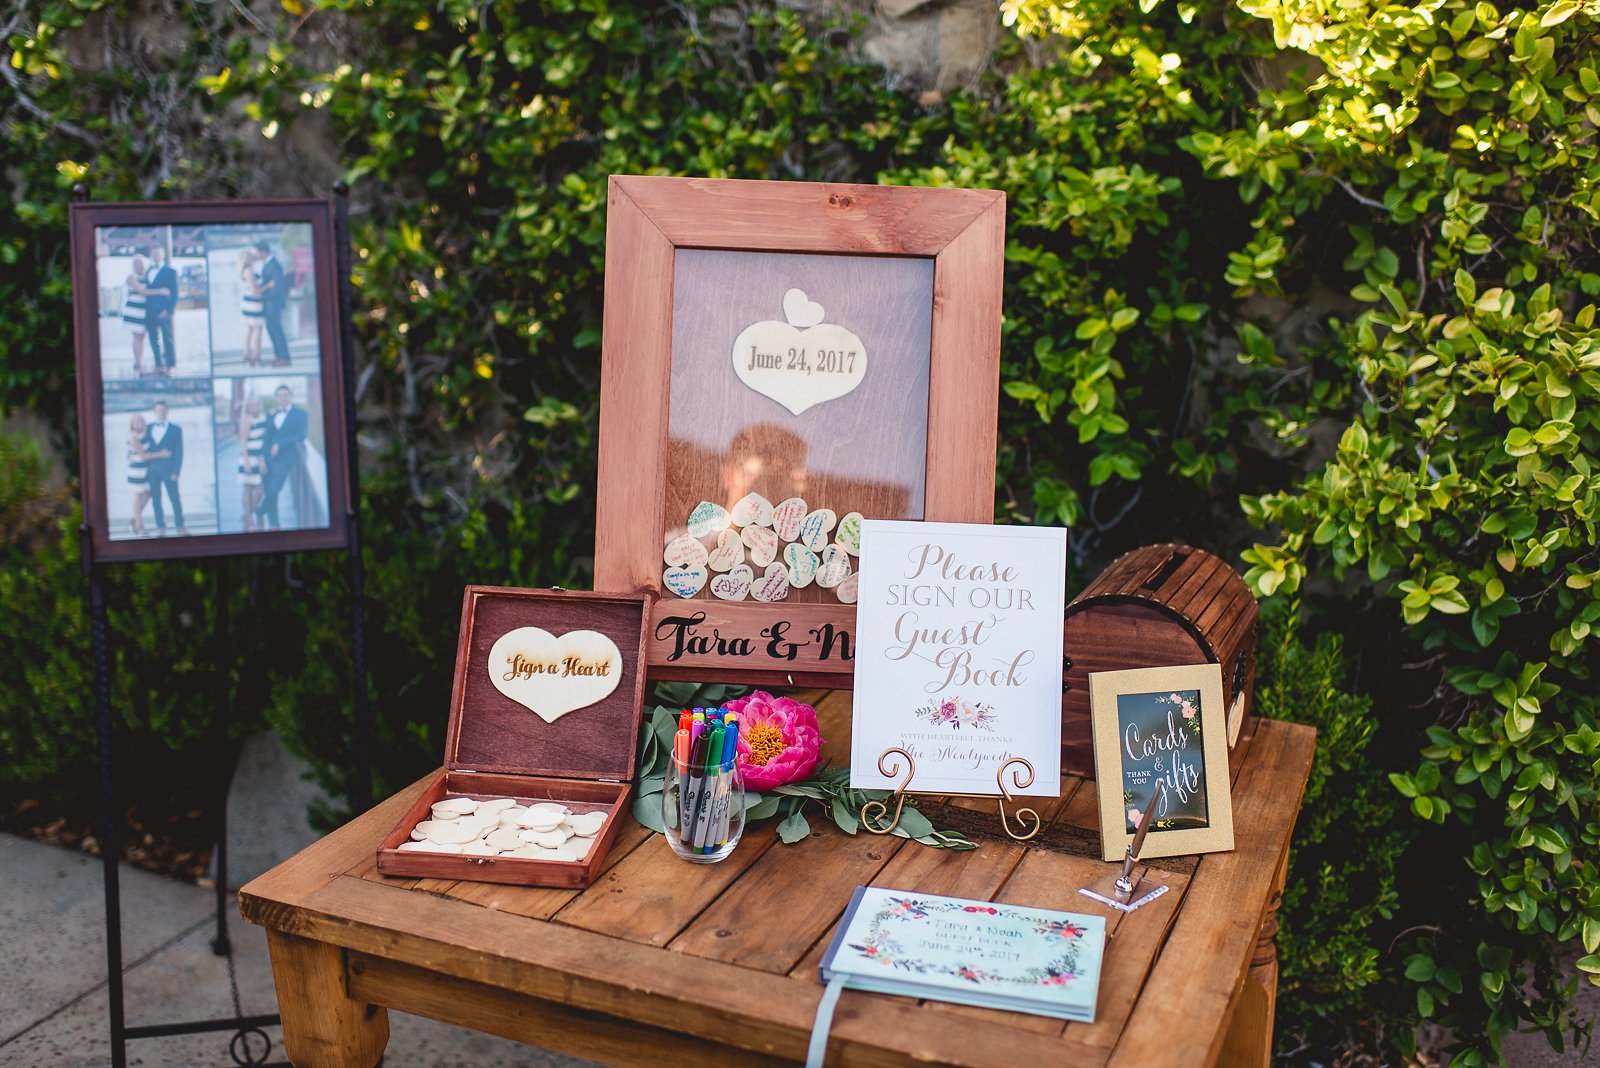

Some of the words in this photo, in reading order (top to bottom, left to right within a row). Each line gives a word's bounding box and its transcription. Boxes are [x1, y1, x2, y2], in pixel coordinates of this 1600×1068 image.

[748, 346, 782, 371] June
[787, 348, 811, 376] 24,
[817, 350, 856, 374] 2017
[903, 544, 1020, 582] Please
[886, 584, 956, 607] SIGN
[968, 588, 1035, 610] OUR
[655, 611, 756, 662] Tara
[760, 620, 811, 662] &
[808, 623, 855, 661] N
[884, 611, 1006, 662] Guest
[503, 654, 546, 681] Sign
[547, 664, 560, 675] a
[561, 657, 611, 678] Heart
[924, 647, 1035, 693] Book
[978, 735, 1013, 743] THANKS
[1125, 711, 1188, 761] Cards
[1127, 770, 1151, 778] THANK
[1154, 757, 1164, 771] &
[1155, 750, 1199, 817] gifts
[987, 926, 1022, 938] Noah
